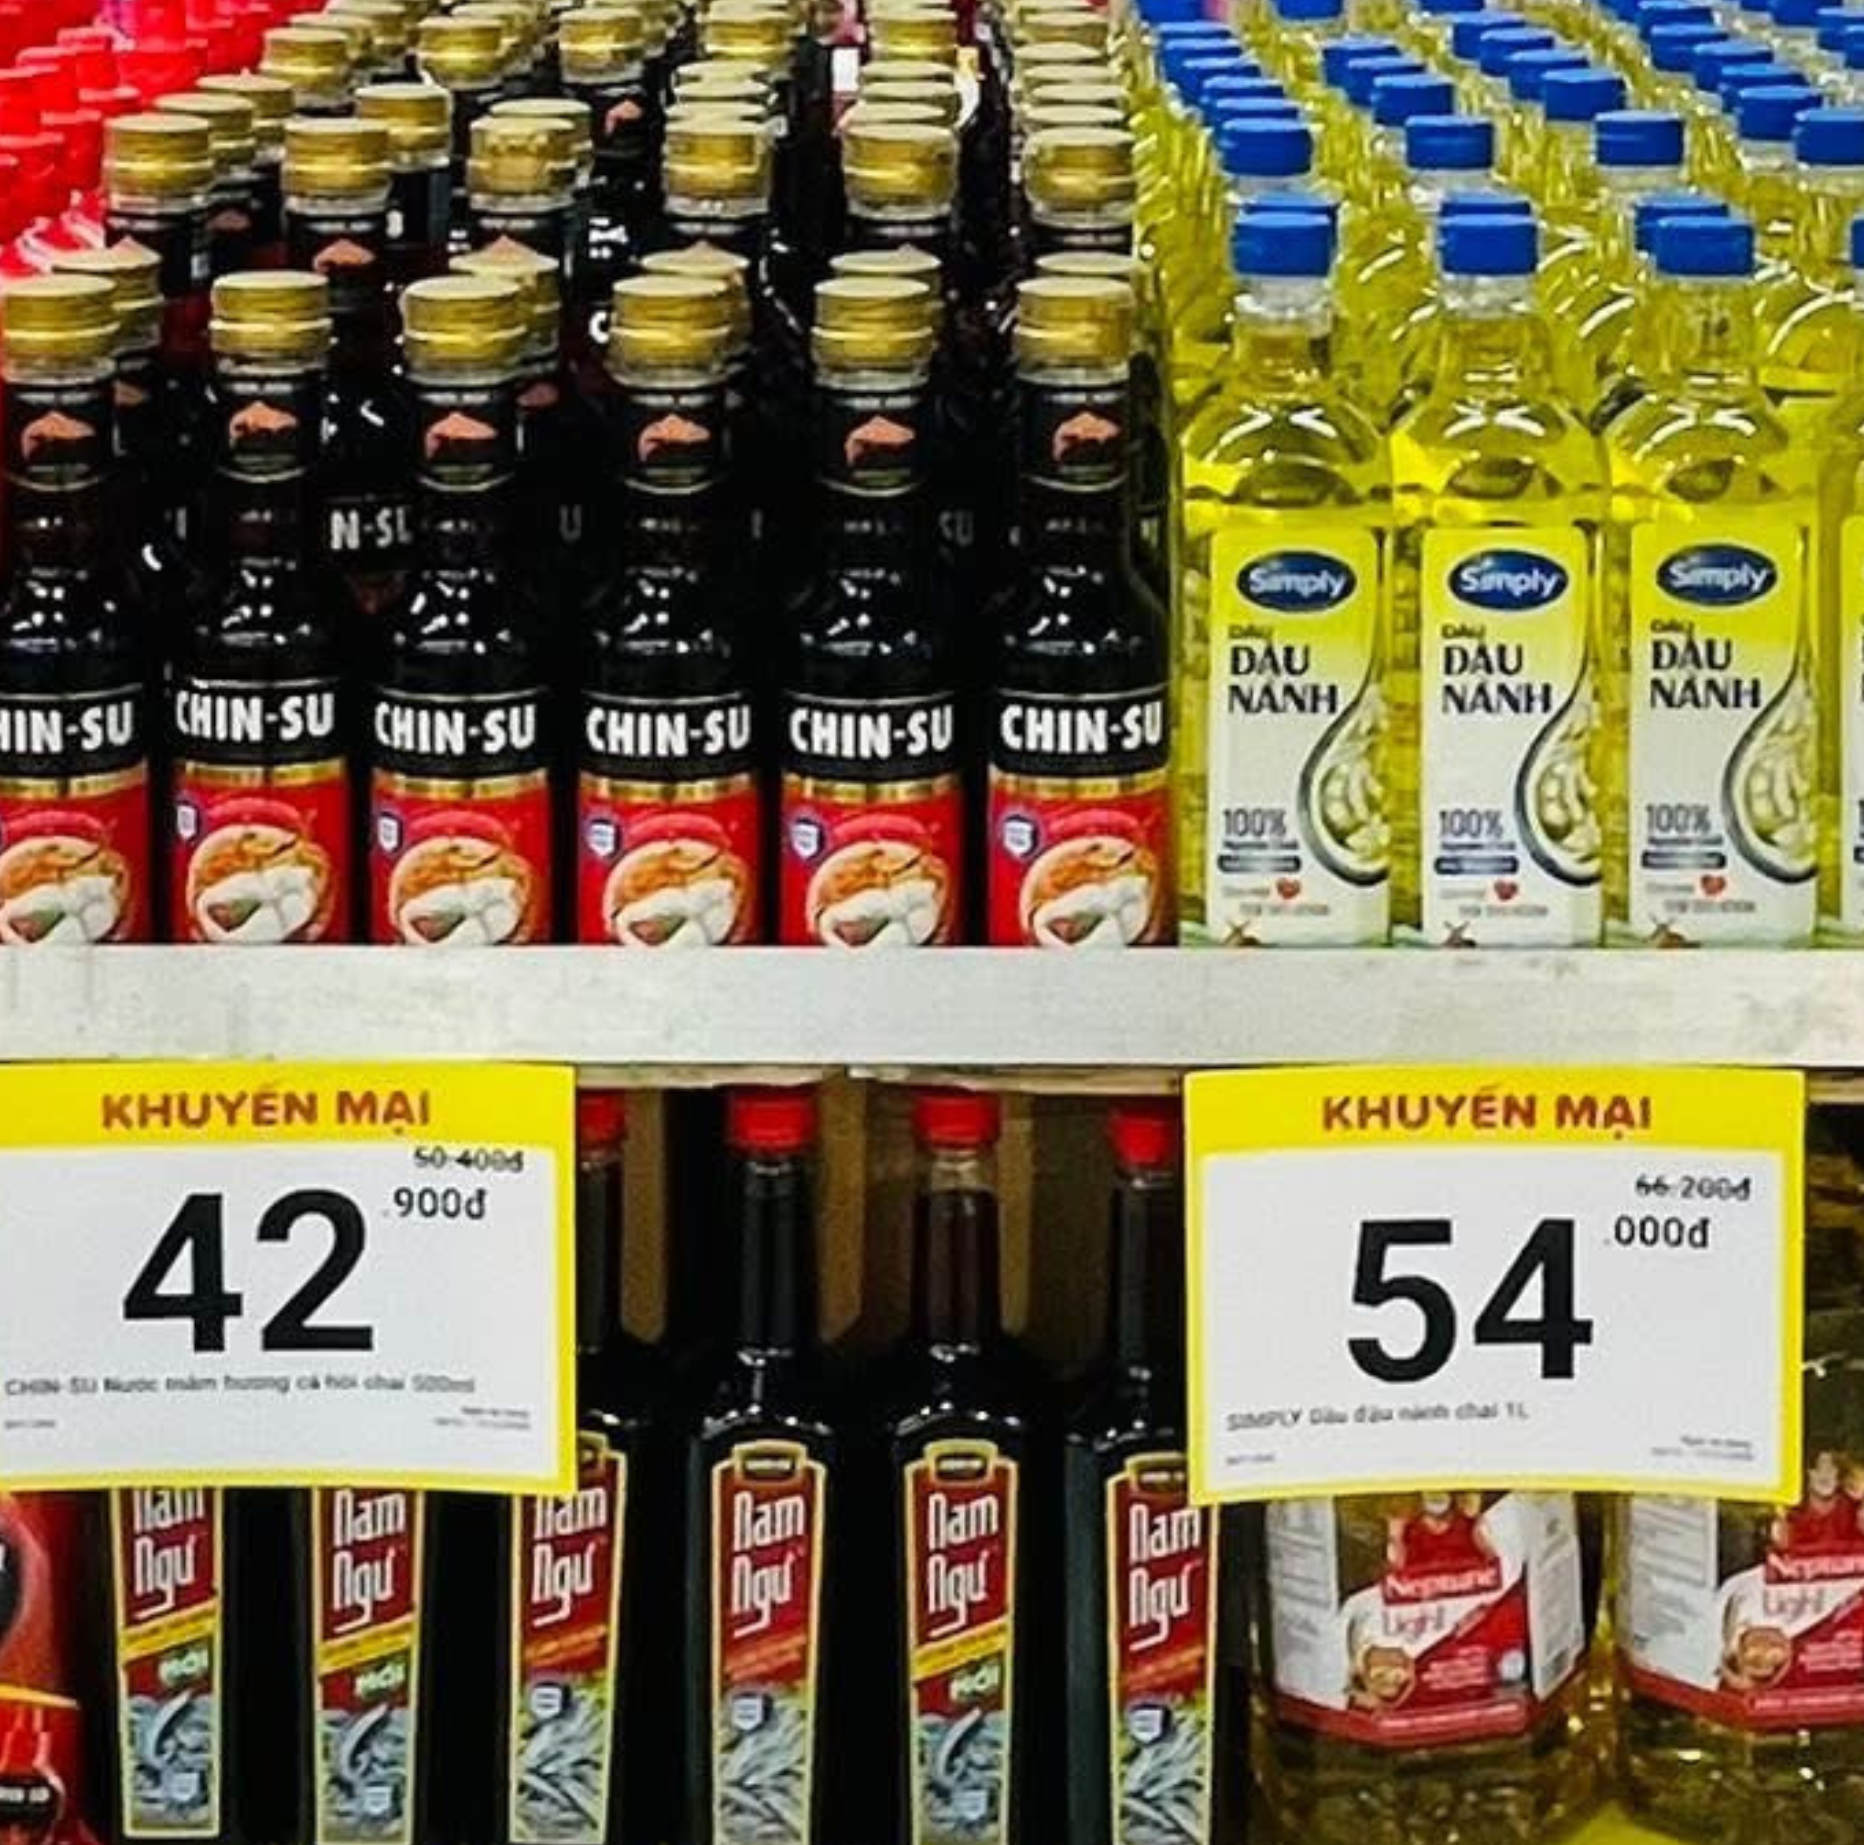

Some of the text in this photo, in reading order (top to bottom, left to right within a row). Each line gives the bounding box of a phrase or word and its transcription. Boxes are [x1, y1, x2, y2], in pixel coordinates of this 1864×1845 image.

[1248, 566, 1347, 598] Simply
[1460, 562, 1561, 598] Simply
[1668, 559, 1769, 592] Simply
[175, 690, 335, 741] CHIN-SU
[374, 702, 536, 755] CHIN-SU
[585, 705, 750, 756] CHIN-SU
[789, 703, 954, 757] CHIN-SU
[1000, 701, 1163, 754] CHIN-SU
[1224, 809, 1286, 838] 100%
[100, 1084, 431, 1136] KHUYẾN MẠI
[1322, 1084, 1652, 1141] KHUYẾN MẠI
[123, 1189, 374, 1353] 42
[1347, 1218, 1593, 1383] 54
